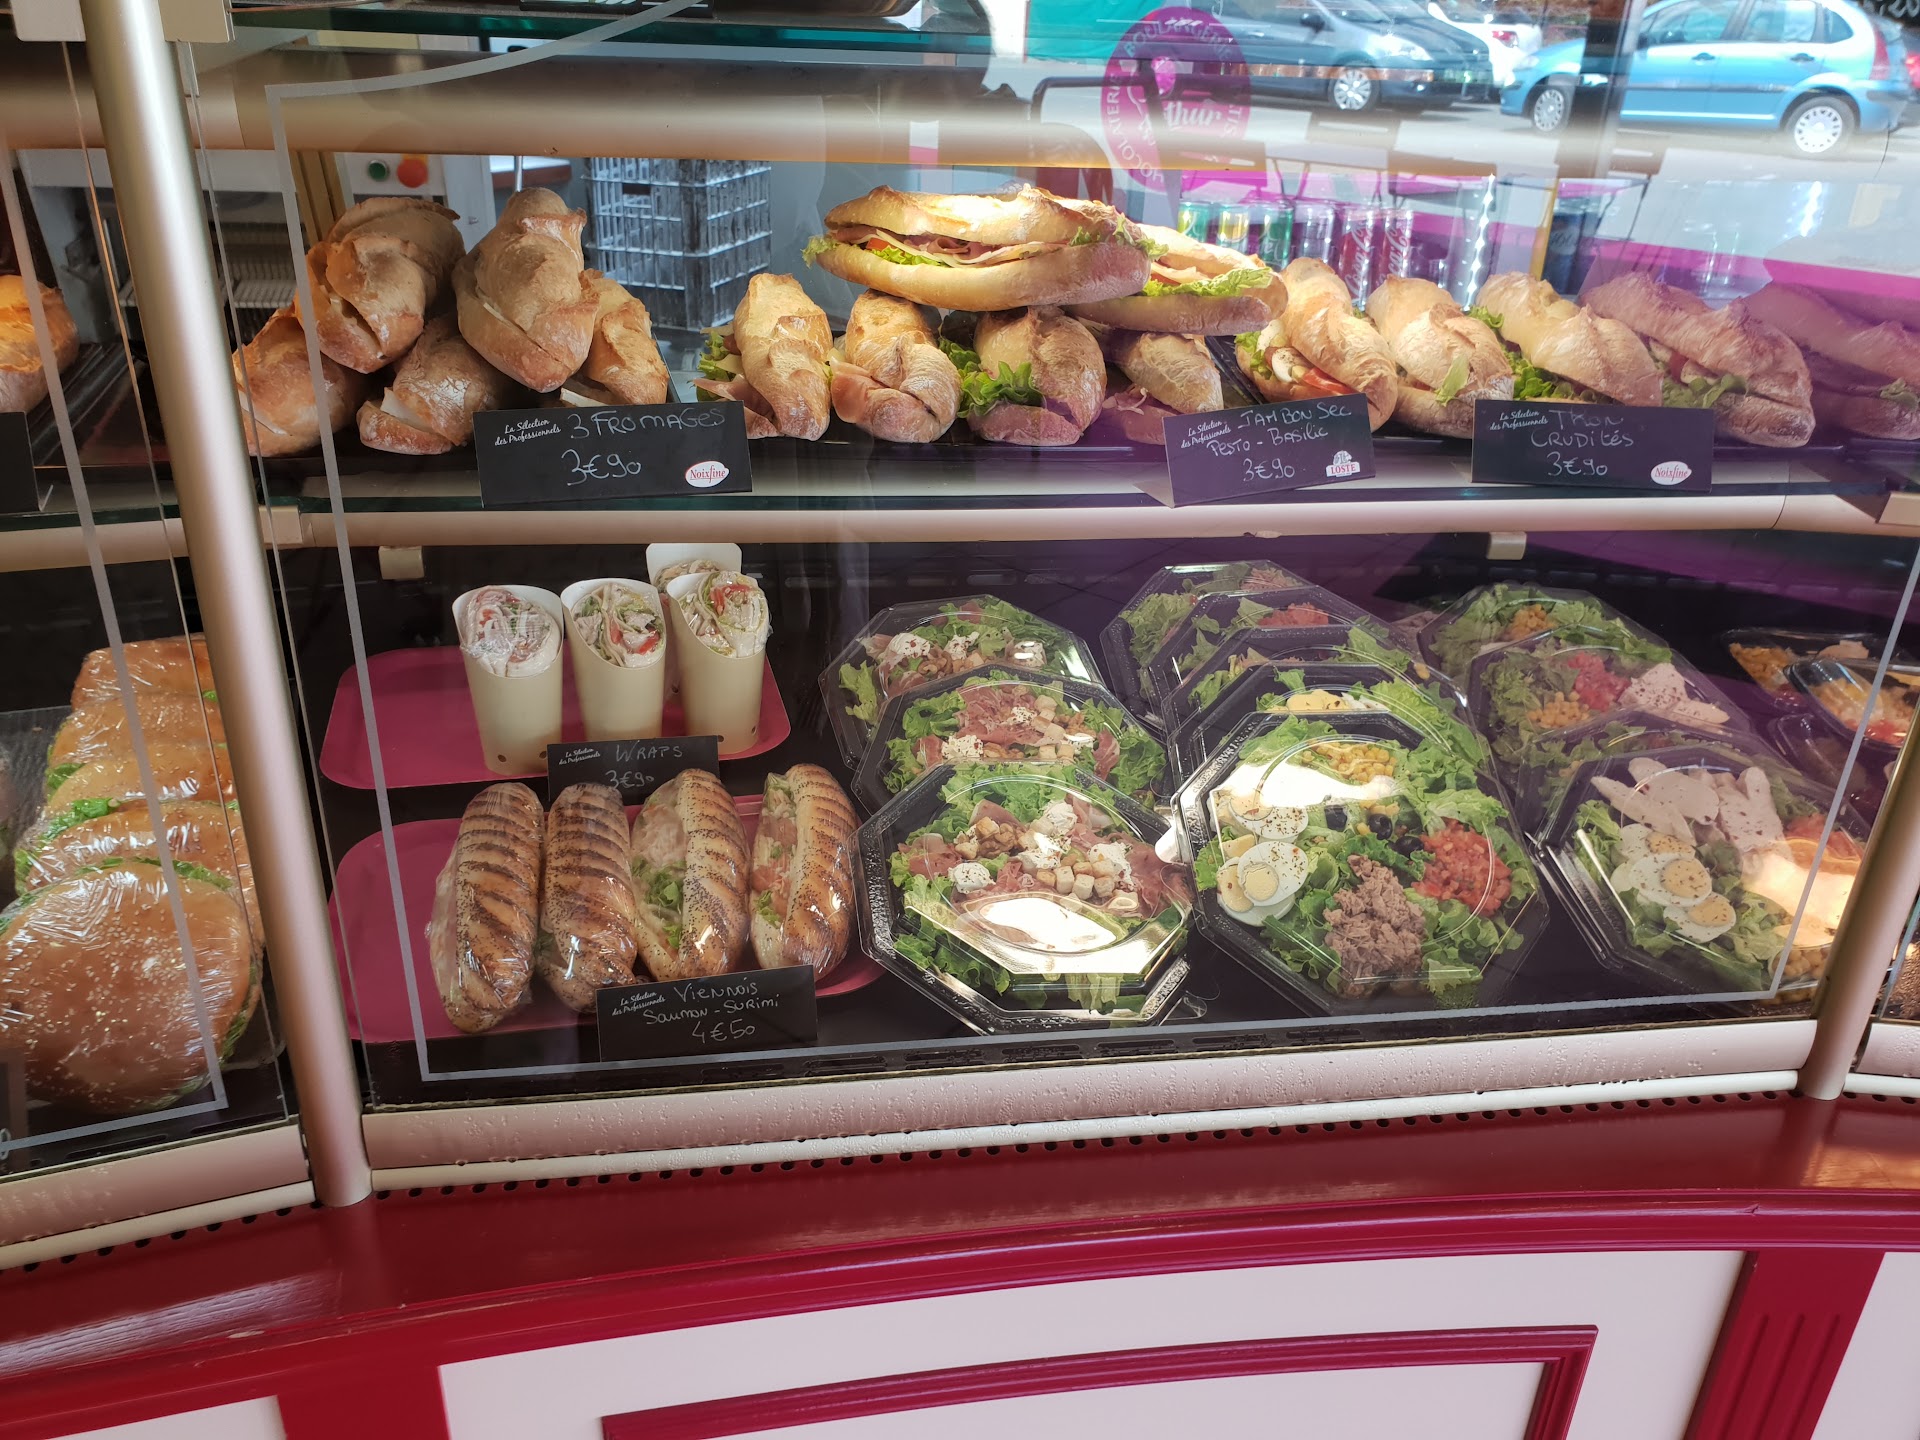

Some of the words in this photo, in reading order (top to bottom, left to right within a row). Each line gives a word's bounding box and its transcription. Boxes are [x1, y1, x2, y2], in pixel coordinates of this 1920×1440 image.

[505, 424, 515, 434] La
[517, 418, 550, 431] Sélection
[567, 413, 590, 439] 3
[1238, 407, 1312, 429] JAMBON
[1490, 422, 1501, 431] des
[1502, 415, 1548, 430] Professionnels
[1500, 412, 1509, 421] La
[495, 436, 508, 446] des
[509, 423, 561, 442] Professionnels
[1181, 439, 1191, 448] des
[1192, 424, 1231, 444] Professionnels
[1188, 427, 1197, 437] La
[561, 449, 642, 487] 3€90
[1243, 458, 1295, 482] 3€90
[1330, 463, 1357, 474] LOSTE
[1546, 451, 1609, 477] 3€90
[616, 739, 683, 762] WRAPS
[605, 769, 655, 789] 3€90
[612, 1007, 622, 1016] des
[623, 994, 666, 1012] Professionnels
[620, 997, 629, 1006] La
